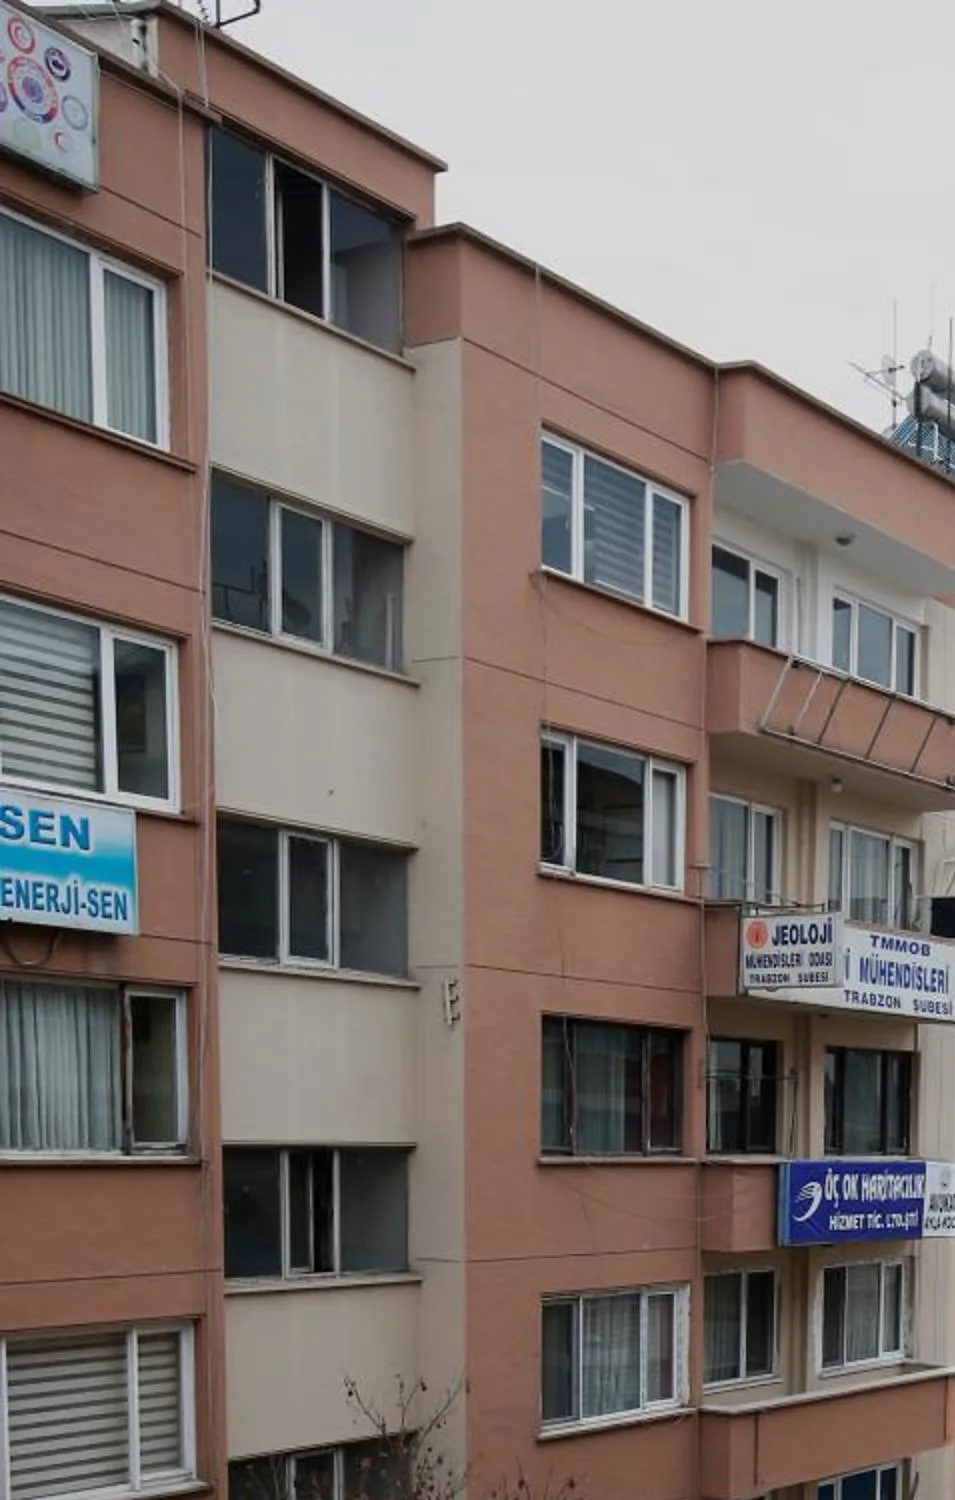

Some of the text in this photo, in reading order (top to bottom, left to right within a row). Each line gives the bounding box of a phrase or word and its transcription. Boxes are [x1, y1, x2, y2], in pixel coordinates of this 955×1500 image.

[1, 878, 128, 921] ENERJİ-SEN
[771, 918, 833, 947] JEOLOJİ
[869, 934, 931, 957] TMMOB
[859, 954, 949, 995] MÜHENDİSLERİ
[843, 989, 901, 1009] TRABZON
